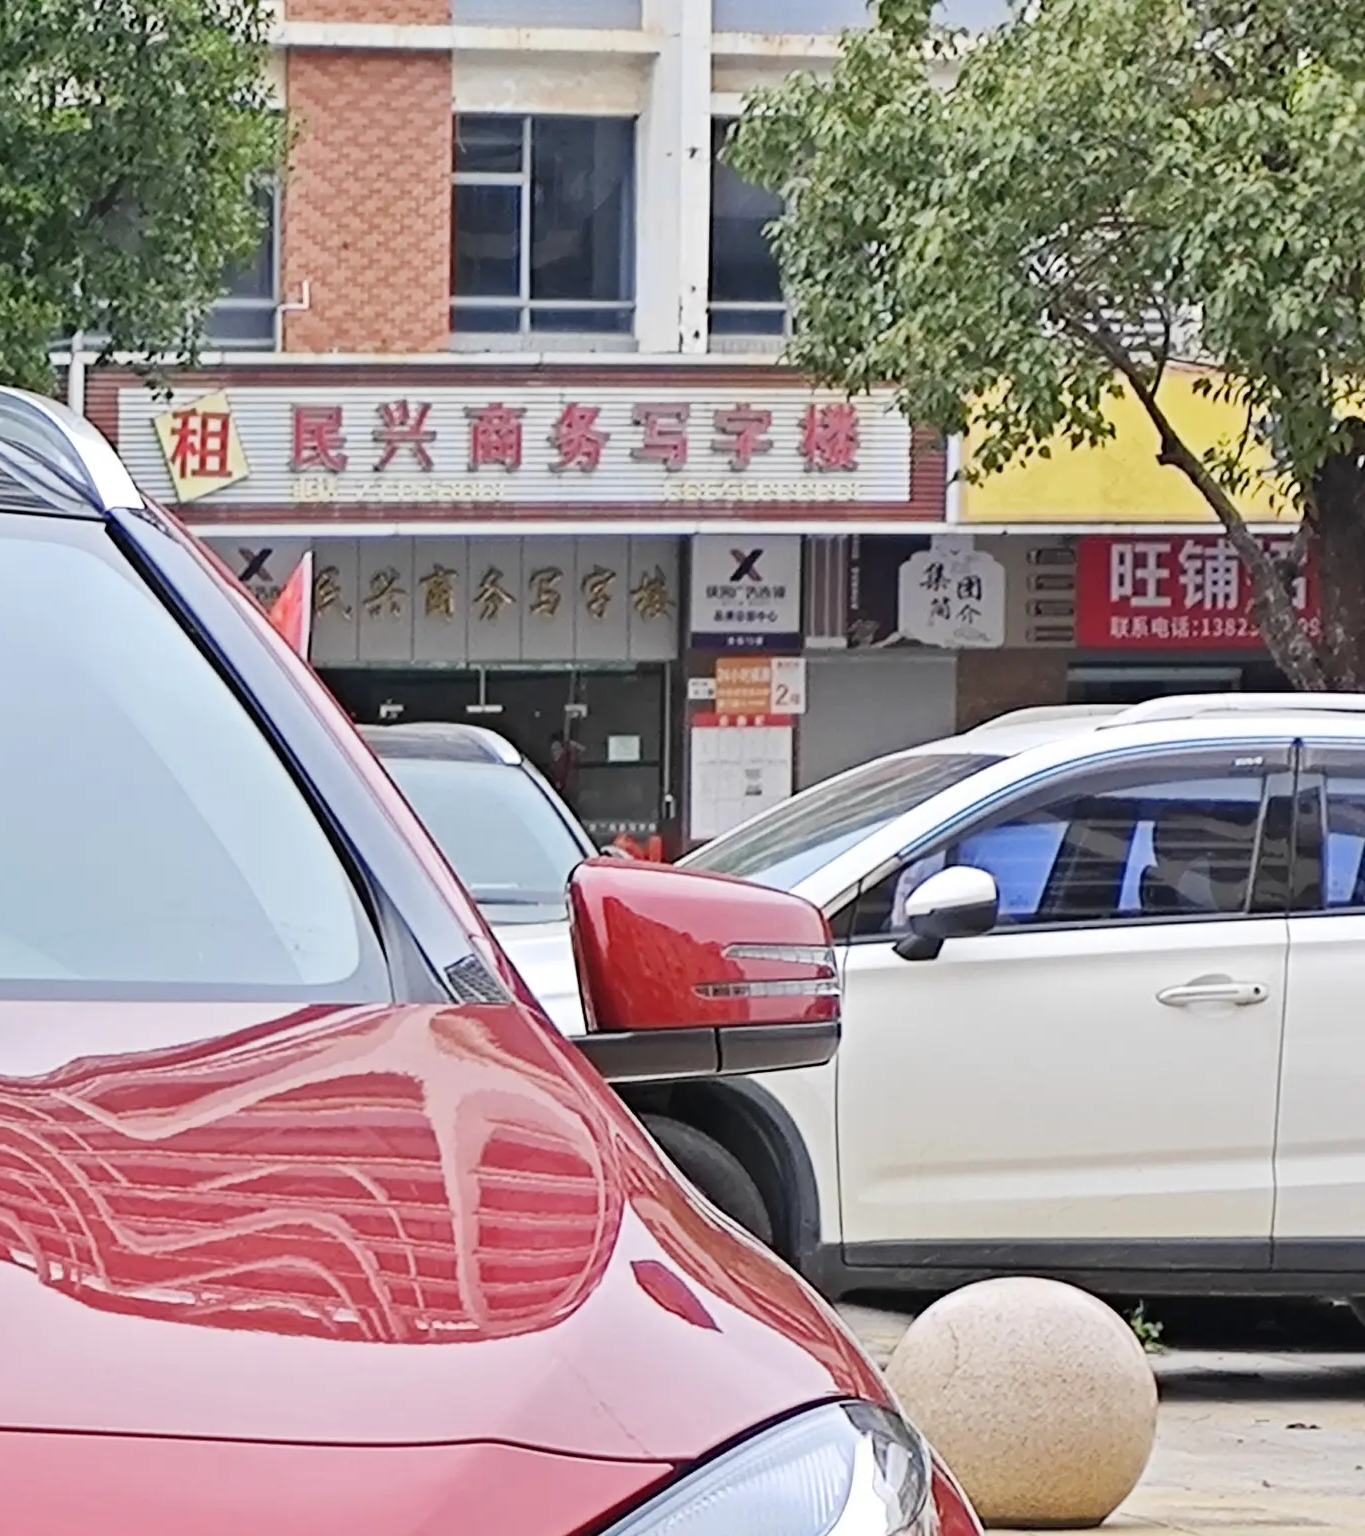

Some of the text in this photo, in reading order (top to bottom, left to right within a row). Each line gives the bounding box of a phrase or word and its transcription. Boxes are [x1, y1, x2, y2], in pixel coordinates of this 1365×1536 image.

[169, 407, 233, 480] 租
[286, 398, 859, 474] 民兴商务写字楼
[313, 563, 677, 624] 民兴商务写字楼
